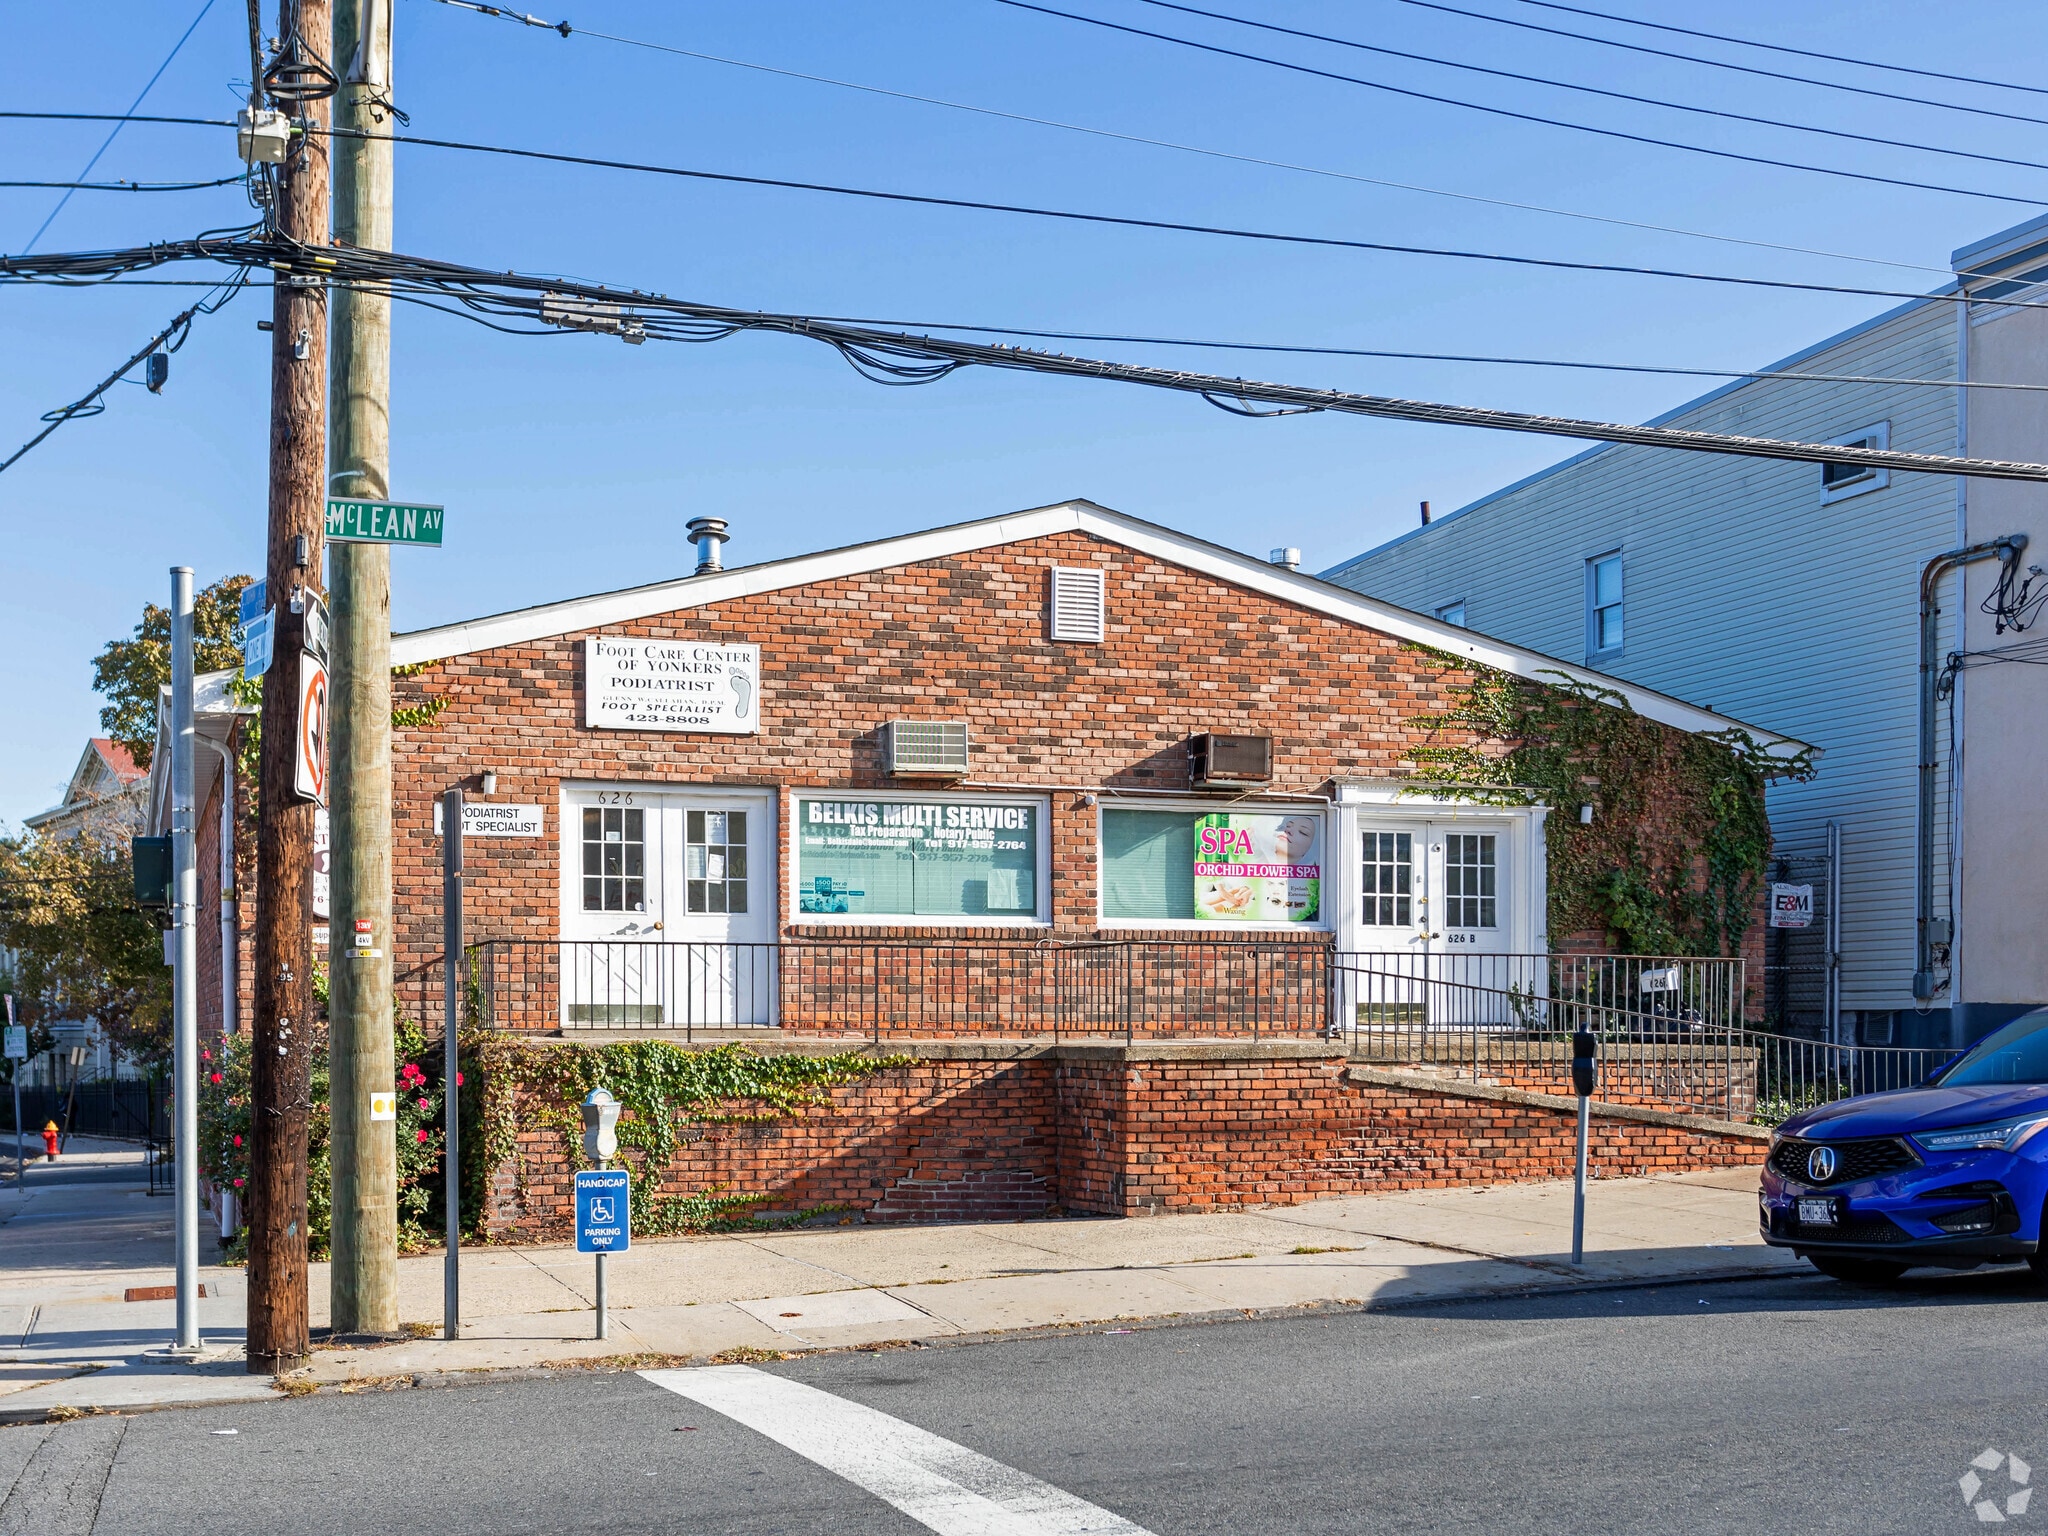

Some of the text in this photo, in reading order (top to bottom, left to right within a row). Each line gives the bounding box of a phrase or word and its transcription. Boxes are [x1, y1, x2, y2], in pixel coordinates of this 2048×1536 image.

[423, 510, 442, 529] AV
[617, 659, 722, 674] OF YONKERS
[611, 677, 715, 692] PODIATRIST
[601, 702, 722, 714] FOOT SPECIALIST
[625, 714, 710, 725] 423-8808
[598, 791, 633, 805] 626
[808, 802, 1028, 829] BELKIS MULTI SERVICE
[475, 821, 538, 832] SPECIALIST
[849, 825, 995, 841] Tax Preparation Notary Public
[924, 839, 943, 848] Tel
[947, 840, 1027, 850] 917-957-2764
[1200, 828, 1254, 855] SPA
[1197, 864, 1318, 878] ORCHID FLOWER SPA
[1776, 895, 1809, 911] E&M
[1223, 907, 1247, 915] Waxing
[1448, 934, 1476, 943] 626 B
[578, 1179, 626, 1188] HANDICAP
[584, 1227, 621, 1236] PARKING
[592, 1237, 614, 1246] ONLY
